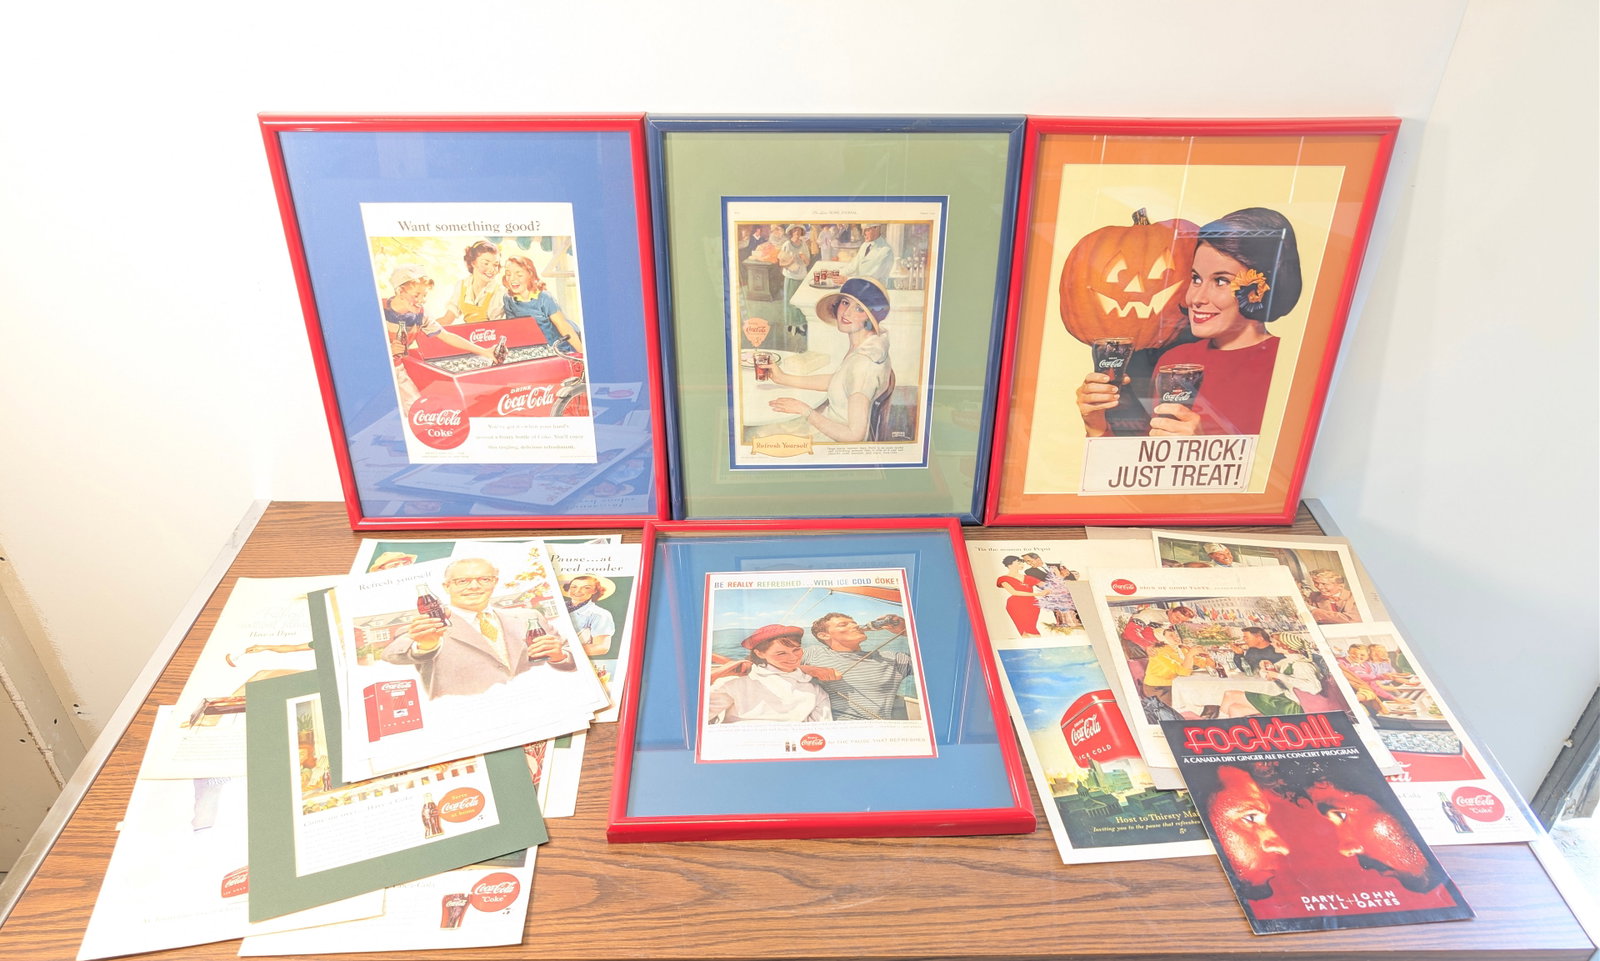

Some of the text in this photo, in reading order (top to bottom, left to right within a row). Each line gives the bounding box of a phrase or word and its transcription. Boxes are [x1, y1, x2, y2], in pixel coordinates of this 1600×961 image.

[397, 221, 541, 234] Want something good?
[470, 330, 497, 344] Coca-Cola
[1099, 358, 1125, 368] Coca-Cola
[510, 385, 532, 394] DRINK
[1162, 391, 1193, 402] Coca-Cola
[498, 385, 555, 415] Coca-Cola
[413, 409, 462, 426] Coca-Cola
[1138, 438, 1247, 462] NO TRICK!
[1108, 463, 1243, 488] JUST TREAT!
[560, 563, 623, 572] red cooler
[714, 581, 724, 589] BE
[814, 579, 833, 587] WITH
[837, 578, 849, 586] ICE
[875, 577, 900, 585] COKE!
[1112, 583, 1135, 591] Coca-Cola
[1070, 713, 1102, 747] Coca-Cola
[1184, 714, 1345, 754] rockbill
[1078, 743, 1113, 760] ICE COLD
[1286, 750, 1321, 759] CONCERT
[1321, 748, 1360, 757] PROGRAM
[441, 795, 481, 814] Coca-Cola
[1456, 794, 1495, 807] Coca-Cola
[1116, 815, 1137, 823] Host
[1148, 813, 1181, 821] Thirsty
[474, 881, 517, 895] Coca-Cola
[1301, 894, 1345, 904] DARYL
[1352, 890, 1396, 903] JOHN
[1305, 898, 1400, 912] HALL OATES
